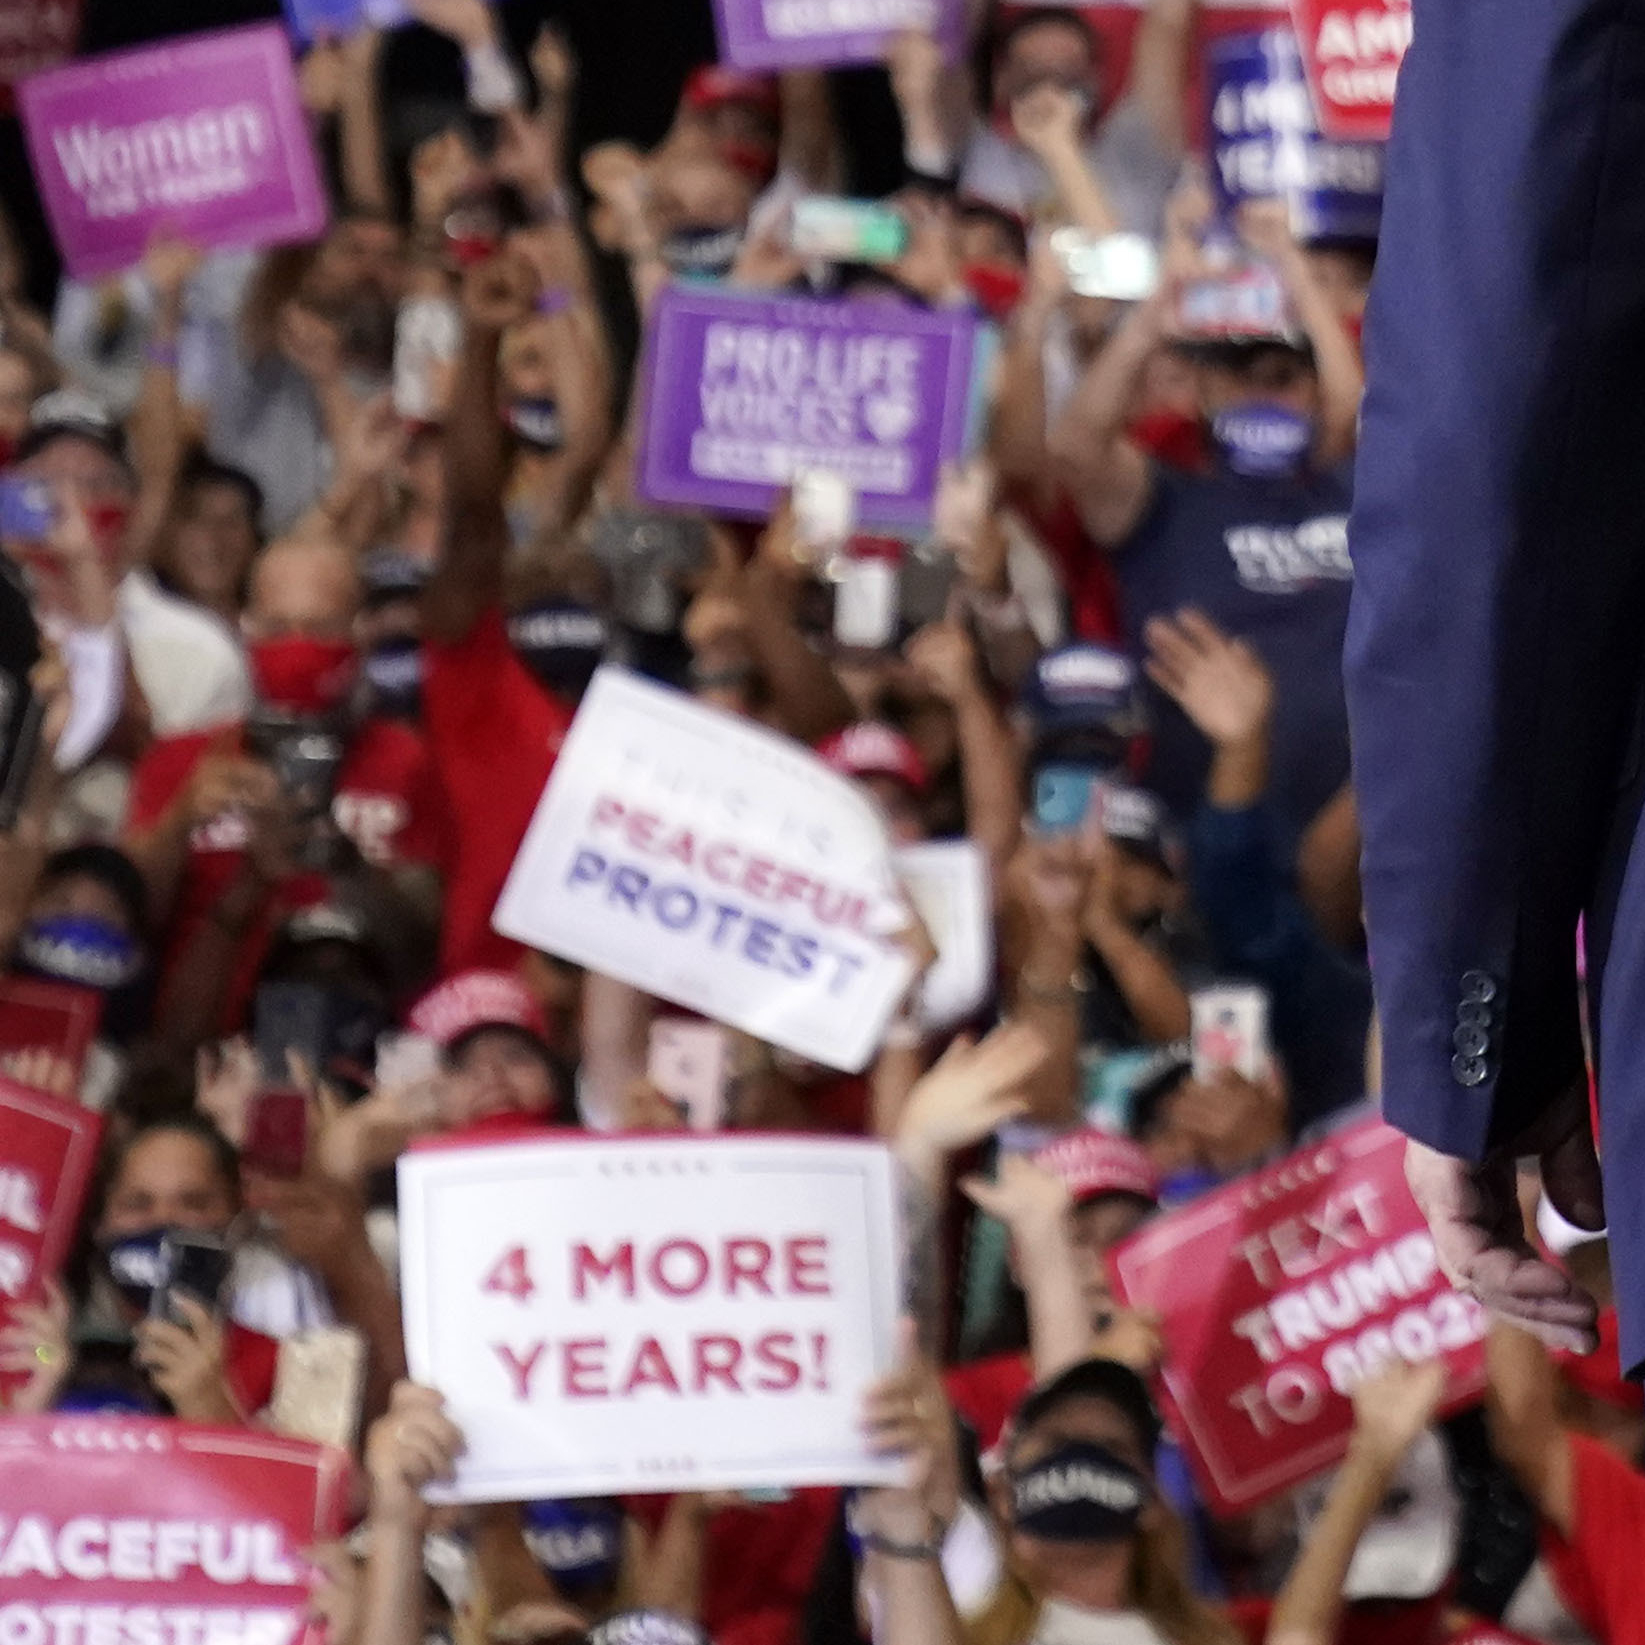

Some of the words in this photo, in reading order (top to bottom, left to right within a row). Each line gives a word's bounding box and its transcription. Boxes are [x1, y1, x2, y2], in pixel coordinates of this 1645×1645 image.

[53, 104, 263, 196] Women
[591, 794, 872, 936] PEACEFUL
[566, 845, 864, 1000] PROTEST
[479, 1245, 536, 1302] 4
[567, 1234, 832, 1300] MORE
[1235, 1180, 1388, 1291] TEXT
[1231, 1232, 1440, 1363] TRUMP
[494, 1331, 832, 1403] YEARS!
[1228, 1362, 1324, 1440] TO
[0, 1514, 299, 1587] ACEFUL
